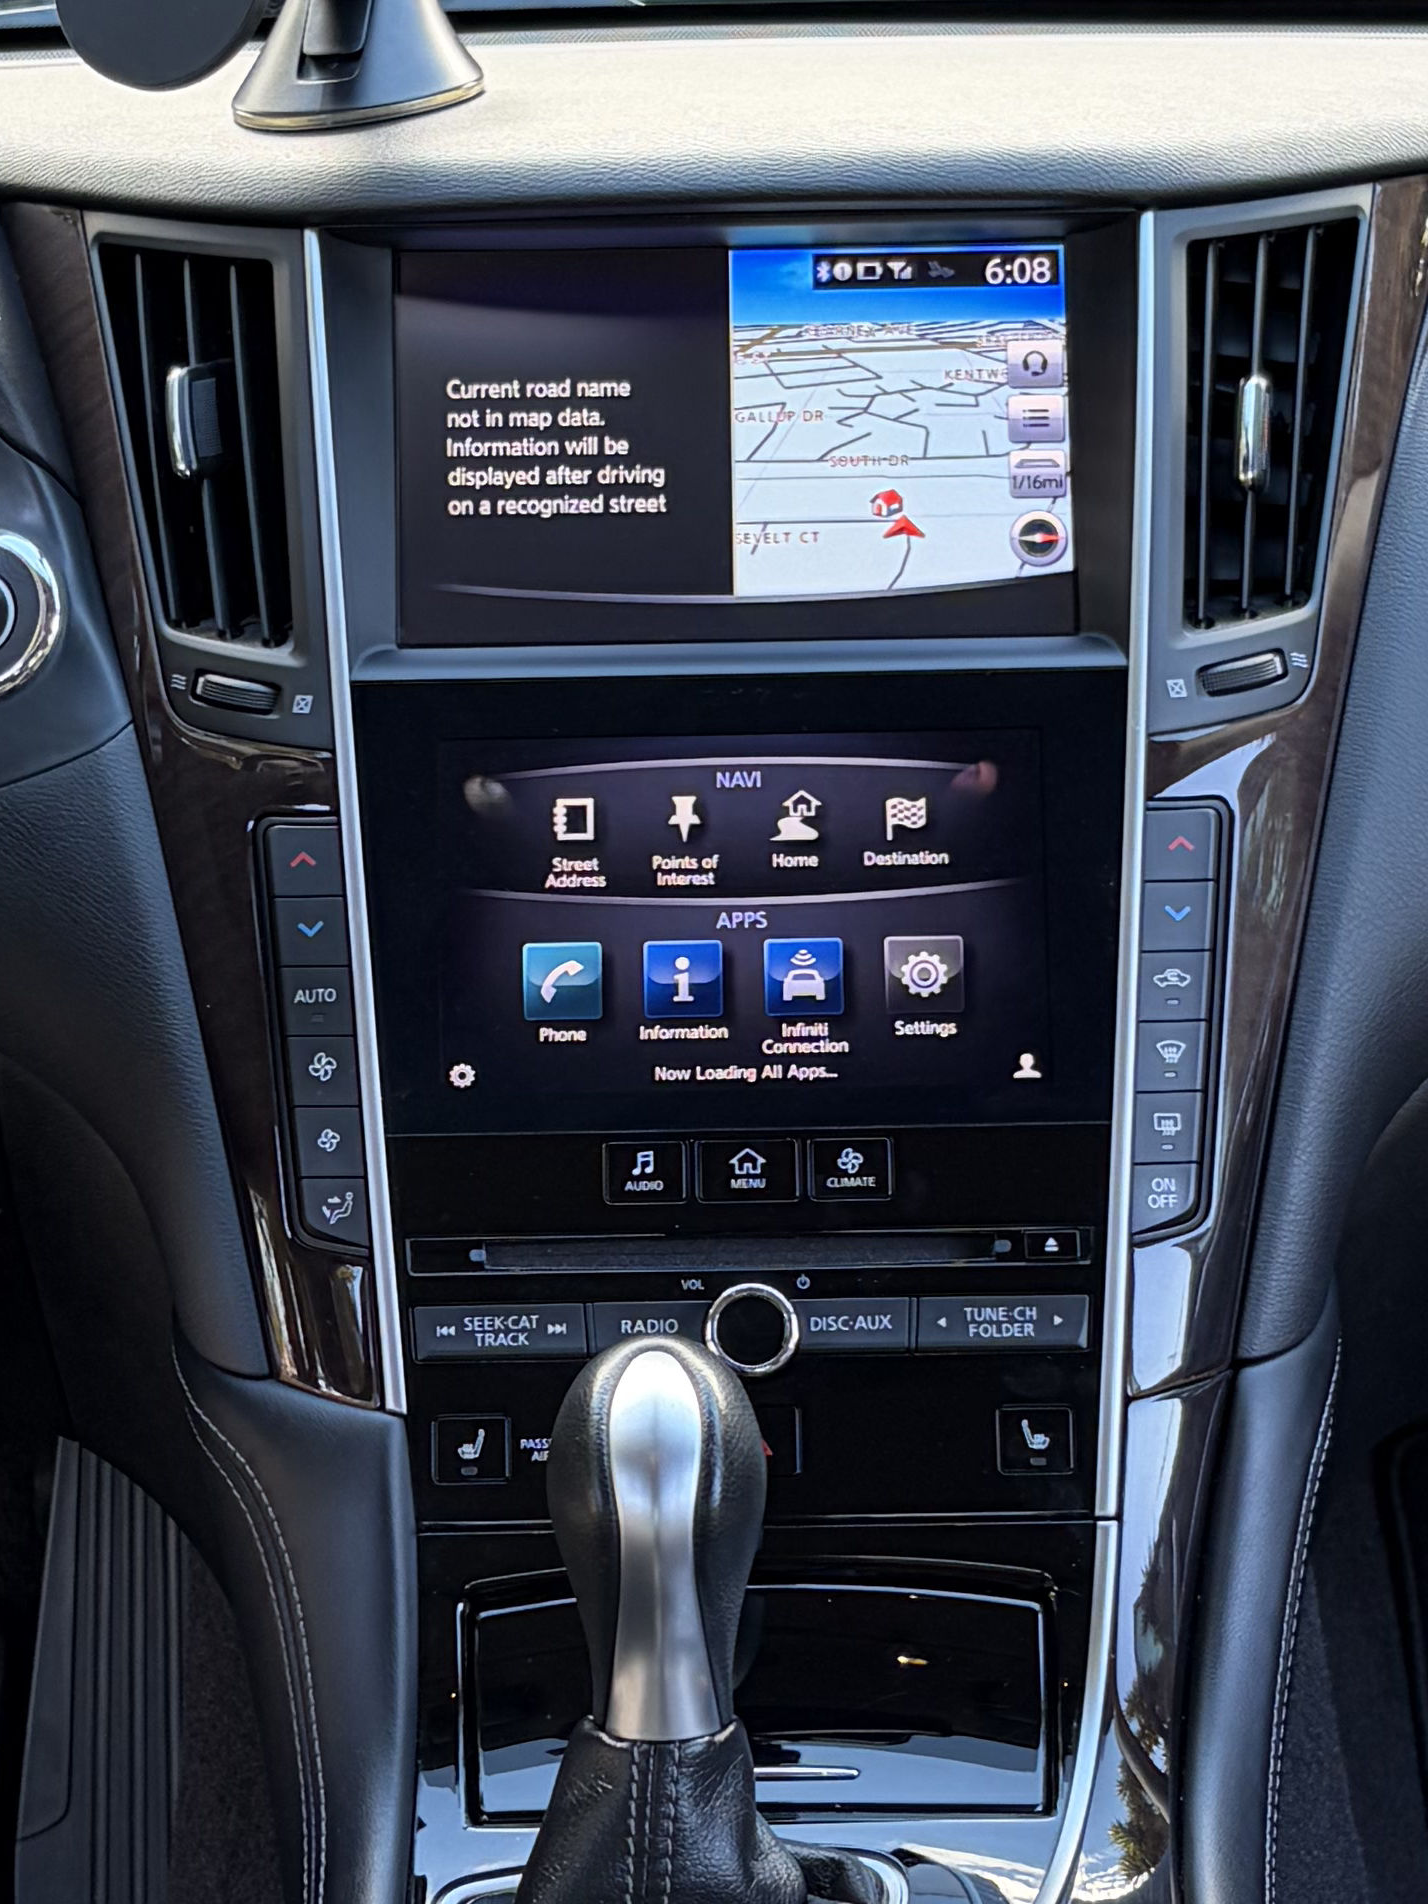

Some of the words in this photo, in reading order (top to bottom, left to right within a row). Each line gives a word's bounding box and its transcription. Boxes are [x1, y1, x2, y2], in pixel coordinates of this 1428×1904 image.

[985, 257, 1051, 285] 6:08
[446, 377, 520, 399] Current
[526, 377, 571, 398] road
[576, 381, 631, 398] name
[447, 408, 480, 428] not
[485, 408, 503, 427] in
[508, 411, 552, 431] map
[557, 408, 605, 427] data.
[735, 409, 797, 423] GALLUP
[803, 409, 824, 422] DR
[446, 437, 559, 457] Information
[565, 436, 598, 456] will
[604, 435, 629, 455] be
[888, 455, 910, 466] DR
[447, 465, 540, 490] displayed
[545, 465, 592, 485] after
[597, 464, 666, 487] driving
[447, 498, 474, 515] on
[478, 499, 491, 515] a
[496, 494, 604, 518] recognized
[609, 494, 667, 514] street
[799, 531, 820, 544] CT
[716, 771, 761, 788] NAVI
[552, 856, 600, 873] Street
[652, 855, 698, 871] Points
[701, 854, 720, 869] of
[772, 853, 819, 867] Home
[863, 850, 949, 866] Destination
[544, 873, 607, 889] Address
[657, 872, 715, 886] Interest
[716, 911, 768, 929] APPS
[293, 988, 337, 1003] AUTO
[539, 1027, 587, 1042] Phone
[639, 1025, 729, 1040] Information
[782, 1022, 829, 1037] Infiniti
[894, 1020, 957, 1037] Settings
[762, 1039, 849, 1054] Connection
[654, 1066, 691, 1081] Now
[696, 1065, 757, 1082] Loading
[761, 1064, 783, 1079] All
[787, 1064, 838, 1081] Apps...
[624, 1180, 664, 1192] AUDIO
[730, 1178, 767, 1189] MENU
[826, 1176, 876, 1188] CLIMATE
[1150, 1177, 1177, 1192] ON
[1148, 1194, 1178, 1208] OFF
[681, 1279, 705, 1290] VOL
[620, 1319, 679, 1335] RADIO
[968, 1322, 1035, 1337] FOLDER
[474, 1332, 529, 1347] TRACK
